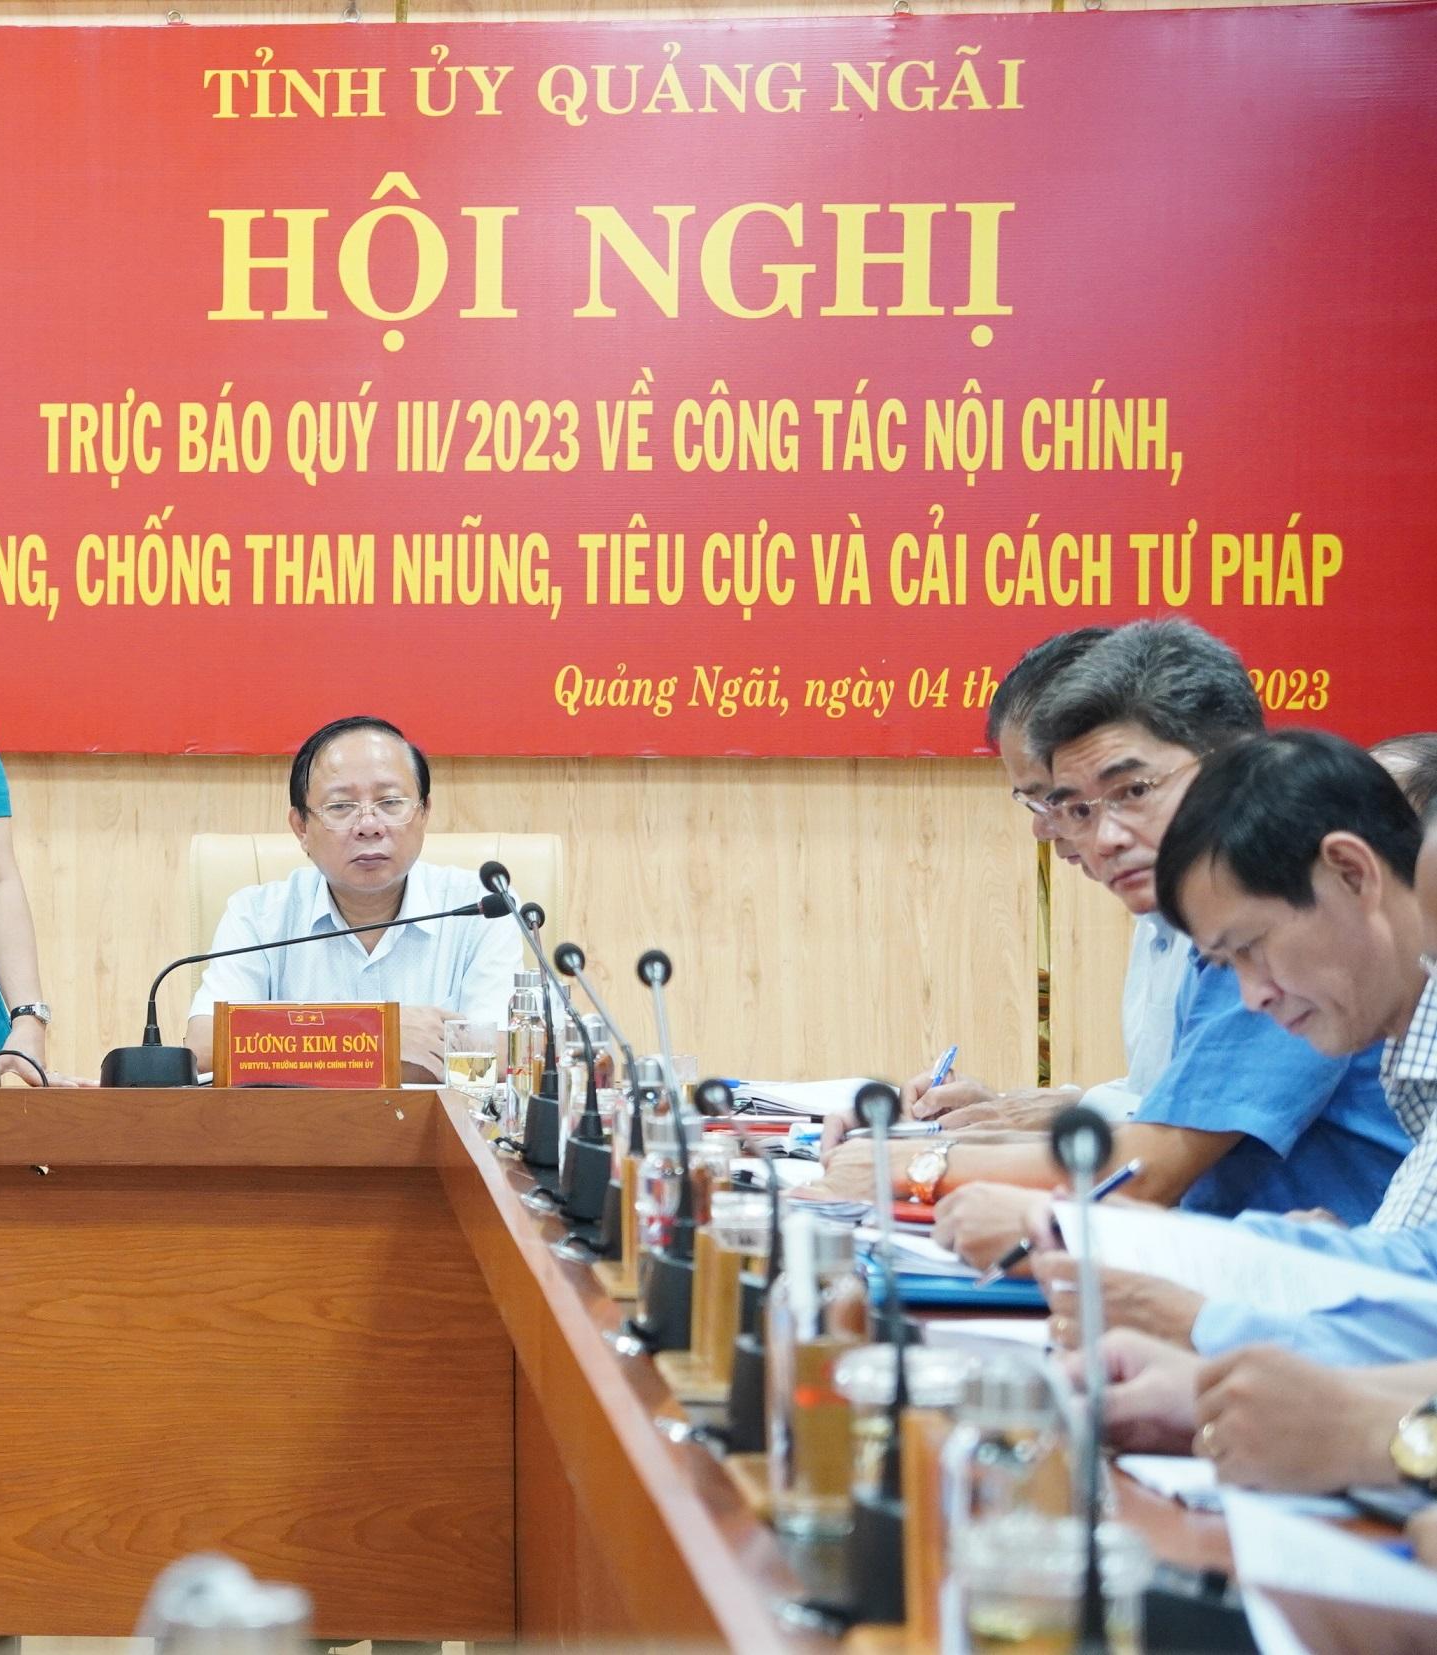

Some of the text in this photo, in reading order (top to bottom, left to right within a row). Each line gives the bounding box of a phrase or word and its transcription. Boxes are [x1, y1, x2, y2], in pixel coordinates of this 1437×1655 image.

[202, 43, 1026, 126] TỈNH ỦY QUẢNG NGÃI
[207, 172, 1016, 352] HỘI NGHỊ
[40, 367, 1183, 488] TRỰC BÁO QUÝ III/2023 VỀ CÔNG TÁC NỘI CHÍNH,
[76, 506, 231, 607] CHỐNG
[244, 533, 376, 606] THAM
[392, 515, 562, 620] NHŨNG,
[579, 514, 684, 607] TIÊU
[702, 519, 796, 621] CỰC
[811, 513, 872, 606] VÀ
[889, 504, 968, 607] CẢI
[984, 514, 1112, 607] CÁCH
[1128, 519, 1199, 607] TƯ
[1210, 512, 1344, 607] PHÁP
[554, 663, 678, 718] Quảng
[687, 665, 790, 718] Ngãi,
[803, 666, 896, 720] ngày
[908, 667, 949, 710] 04
[234, 1032, 379, 1054] LƯƠNG KIM SƠN
